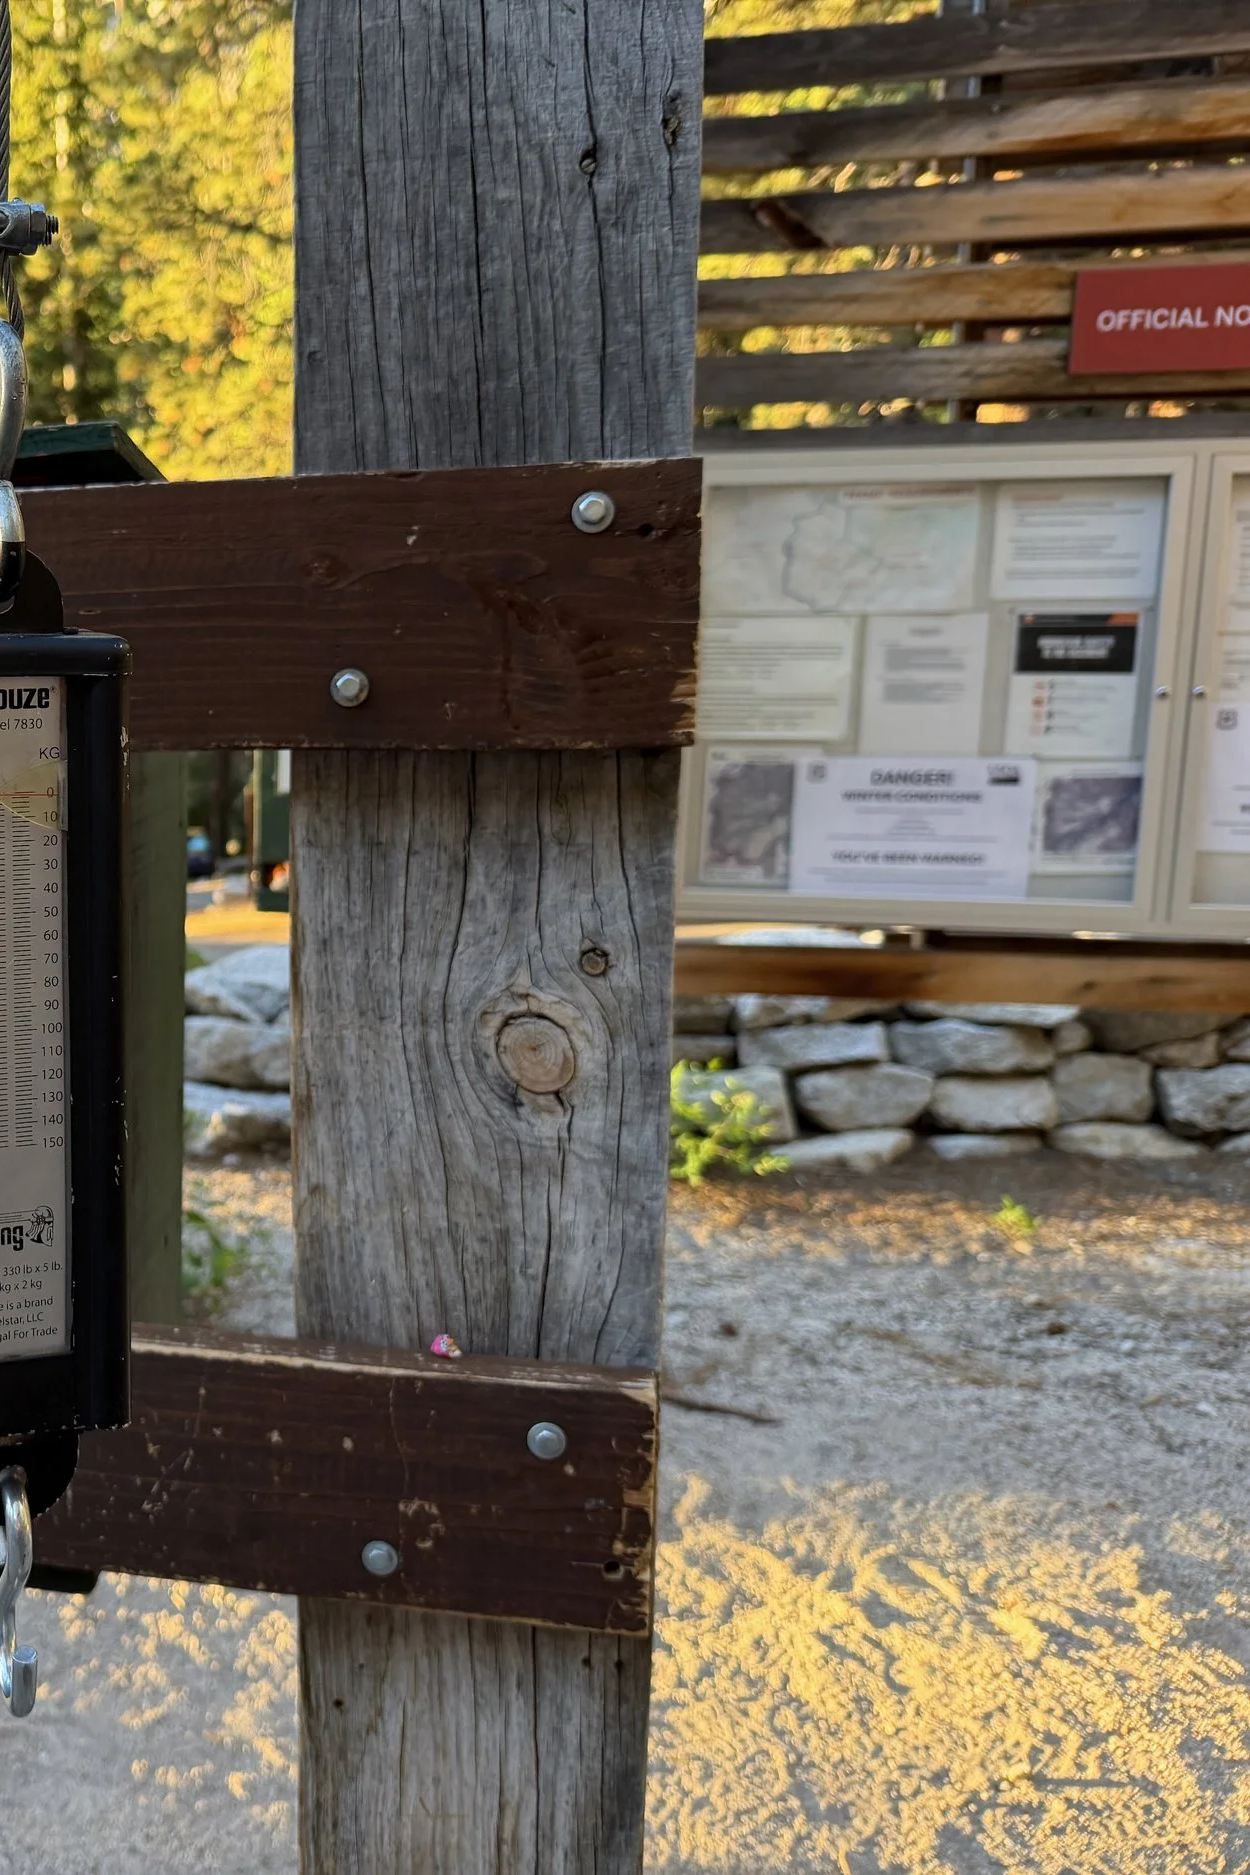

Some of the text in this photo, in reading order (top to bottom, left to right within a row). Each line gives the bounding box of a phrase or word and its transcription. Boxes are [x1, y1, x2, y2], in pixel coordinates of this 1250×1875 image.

[1096, 305, 1250, 332] OFFICIAL NO
[14, 718, 43, 730] 7830
[39, 747, 60, 760] KG
[47, 787, 54, 798] 0
[44, 811, 58, 822] 10
[43, 835, 58, 846] 20
[43, 858, 58, 870] 30
[43, 882, 58, 893] 40
[44, 906, 58, 917] 50
[44, 929, 58, 941] 60
[44, 952, 58, 964] 70
[44, 976, 59, 987] 80
[44, 999, 59, 1010] 90
[42, 1022, 62, 1034] 100
[42, 1045, 62, 1056] 110
[42, 1068, 63, 1080] 120
[42, 1090, 63, 1102] 130
[42, 1113, 63, 1125] 140
[43, 1136, 63, 1148] 150
[2, 1266, 21, 1277] 330
[23, 1264, 32, 1274] lb
[43, 1262, 48, 1272] 5
[51, 1260, 63, 1271] lb.
[0, 1281, 11, 1293] kg
[22, 1280, 28, 1289] 2
[30, 1278, 42, 1290] kg
[6, 1301, 13, 1311] is
[24, 1296, 53, 1308] brand
[26, 1311, 44, 1323] LLC
[13, 1328, 28, 1339] For
[31, 1325, 58, 1337] Trade
